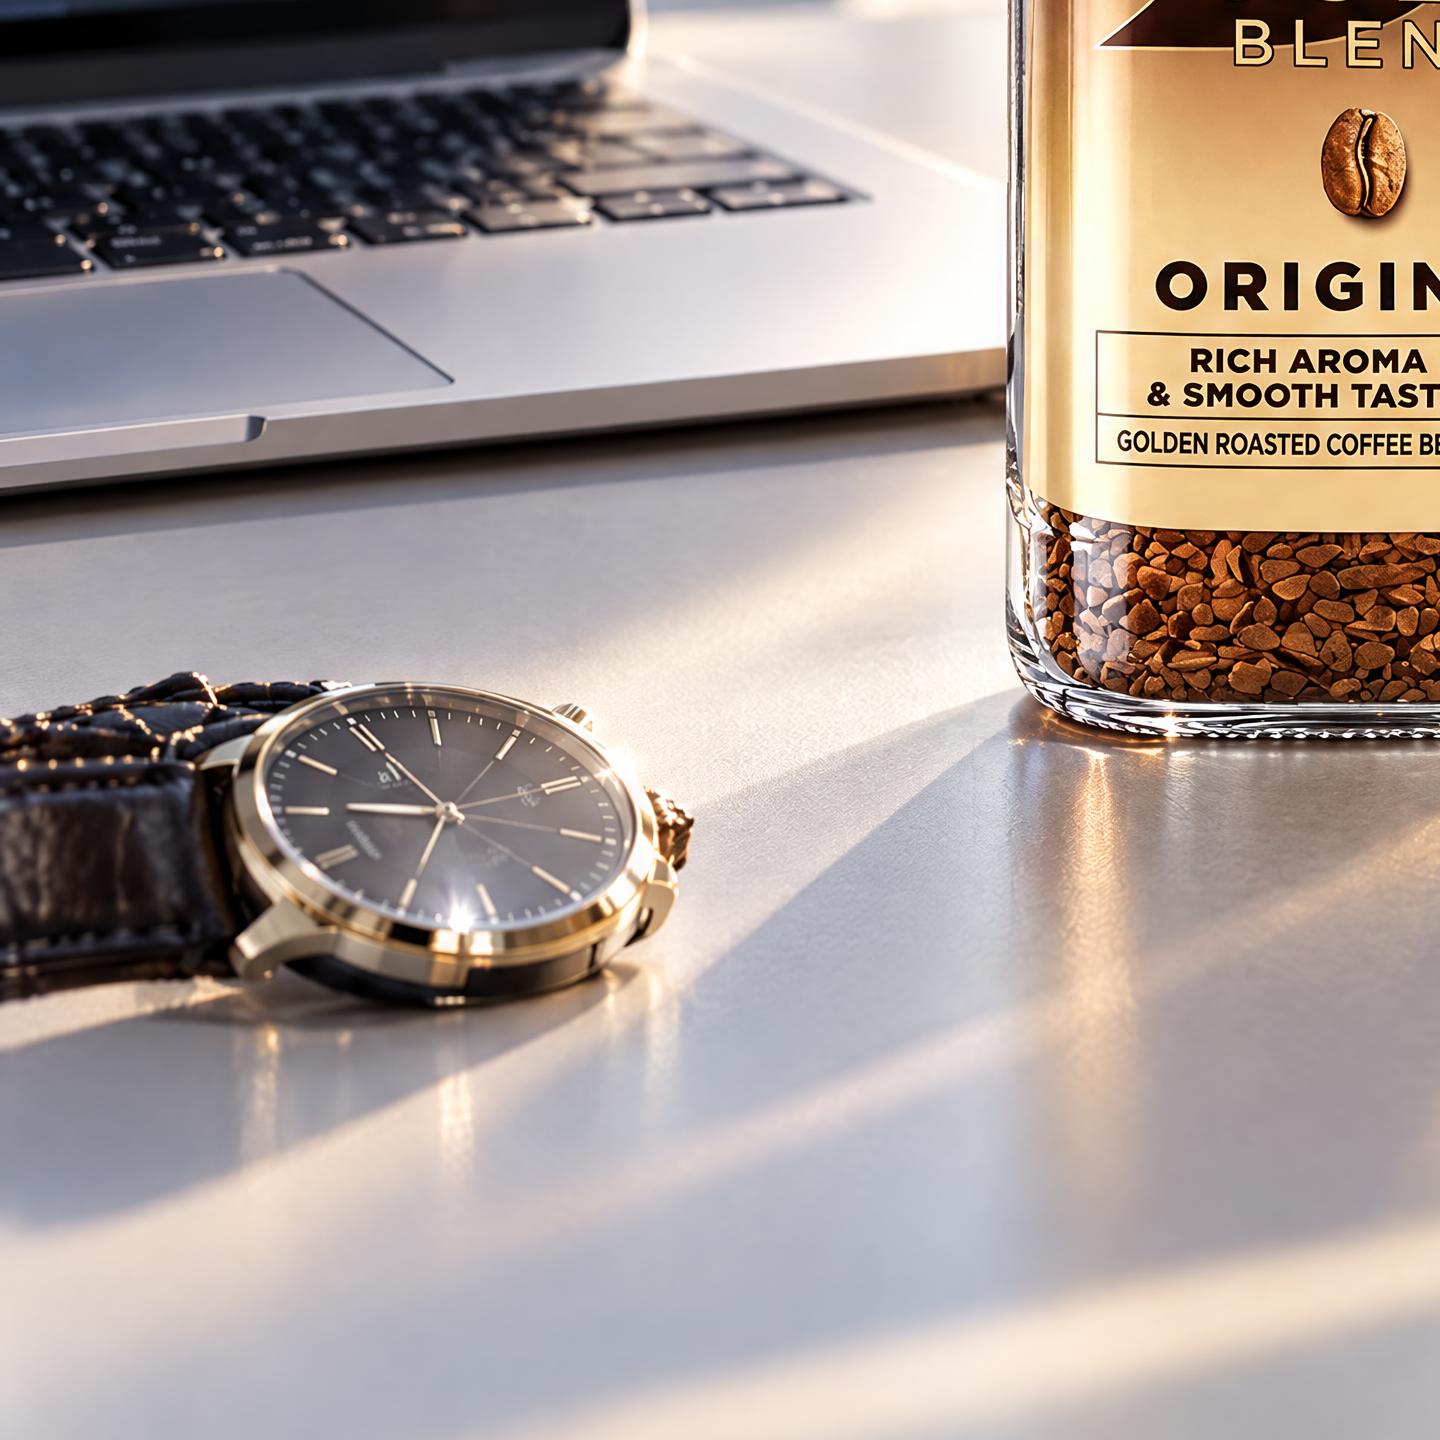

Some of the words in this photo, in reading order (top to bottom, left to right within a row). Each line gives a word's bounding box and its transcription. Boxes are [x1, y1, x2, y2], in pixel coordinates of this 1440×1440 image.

[1190, 348, 1276, 374] RICH
[1288, 348, 1427, 374] AROMA
[1147, 382, 1170, 407] &
[1183, 382, 1339, 409] SMOOTH
[1117, 429, 1209, 455] GOLDEN
[1216, 432, 1320, 456] ROASTED
[1326, 432, 1412, 457] COFFEE
